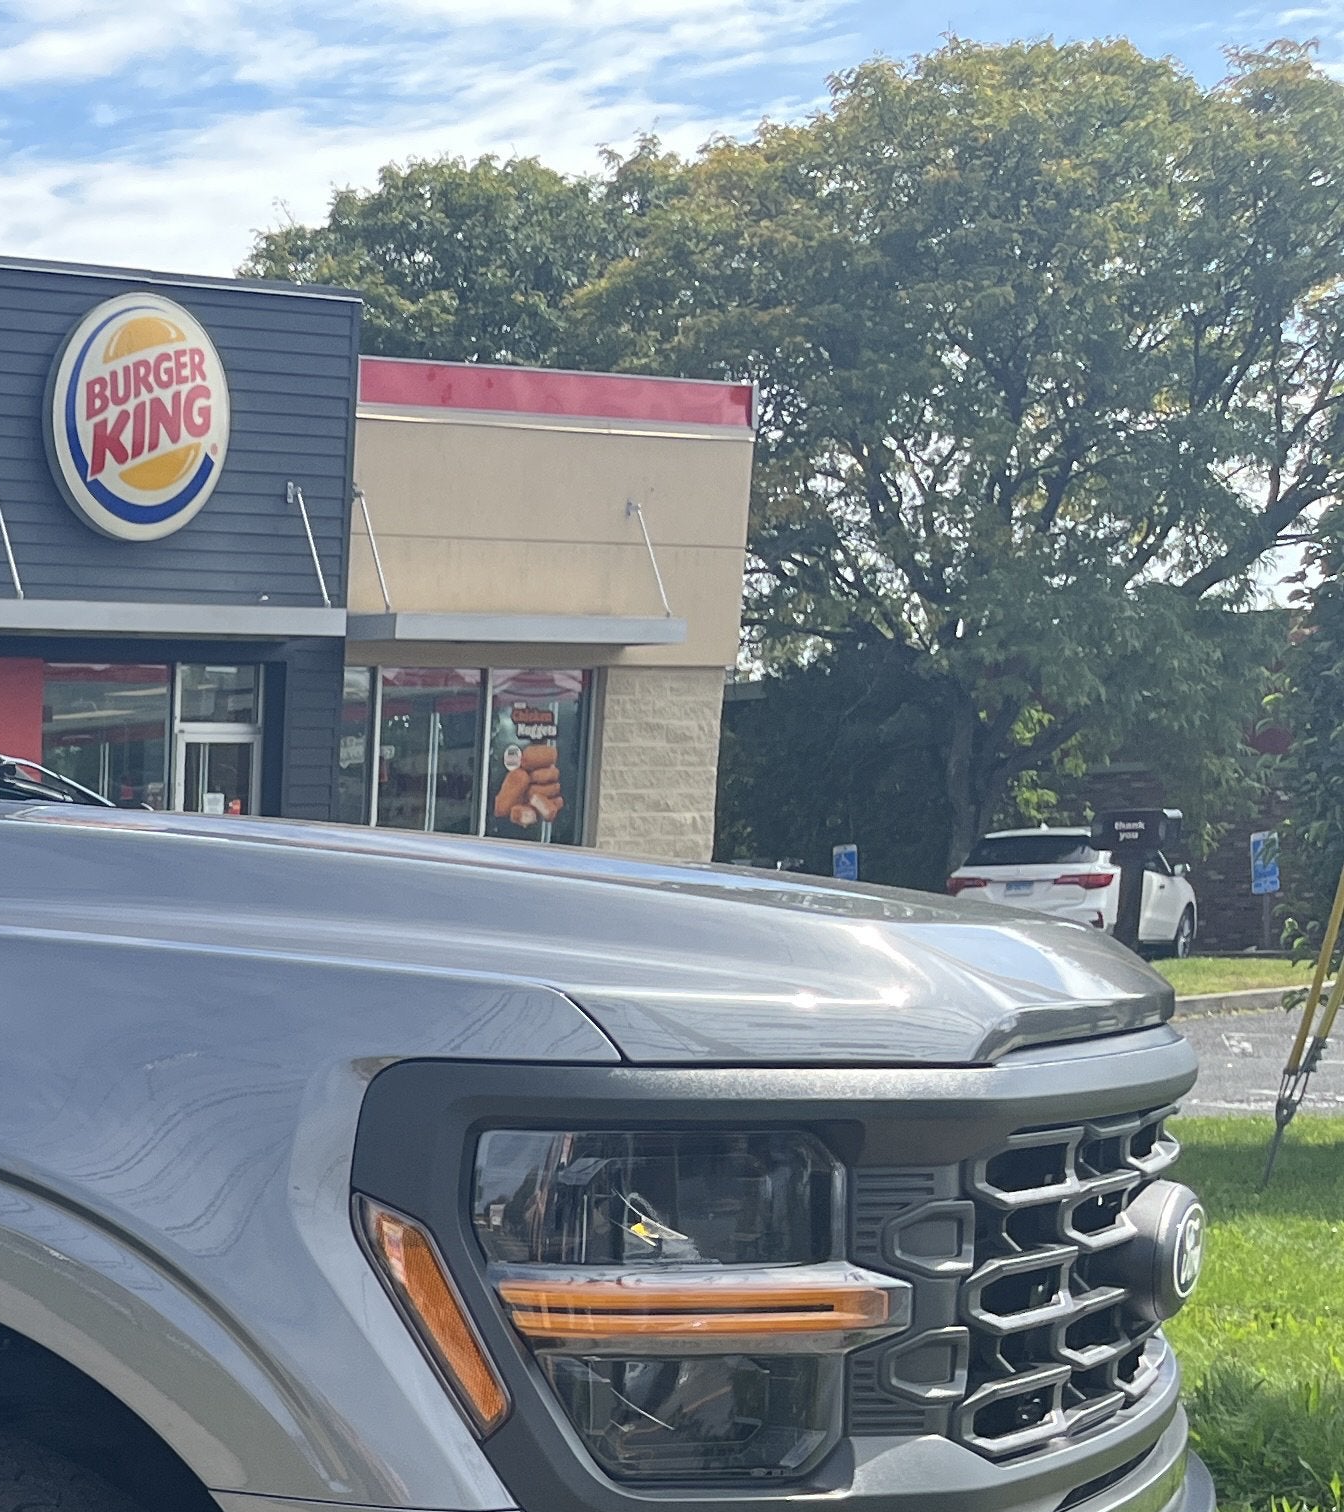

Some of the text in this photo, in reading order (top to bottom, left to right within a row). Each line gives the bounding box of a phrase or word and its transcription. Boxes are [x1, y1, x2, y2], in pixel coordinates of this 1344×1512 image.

[84, 347, 207, 421] BURGER
[87, 385, 212, 481] KING
[1114, 821, 1145, 830] thank
[1118, 831, 1139, 841] you
